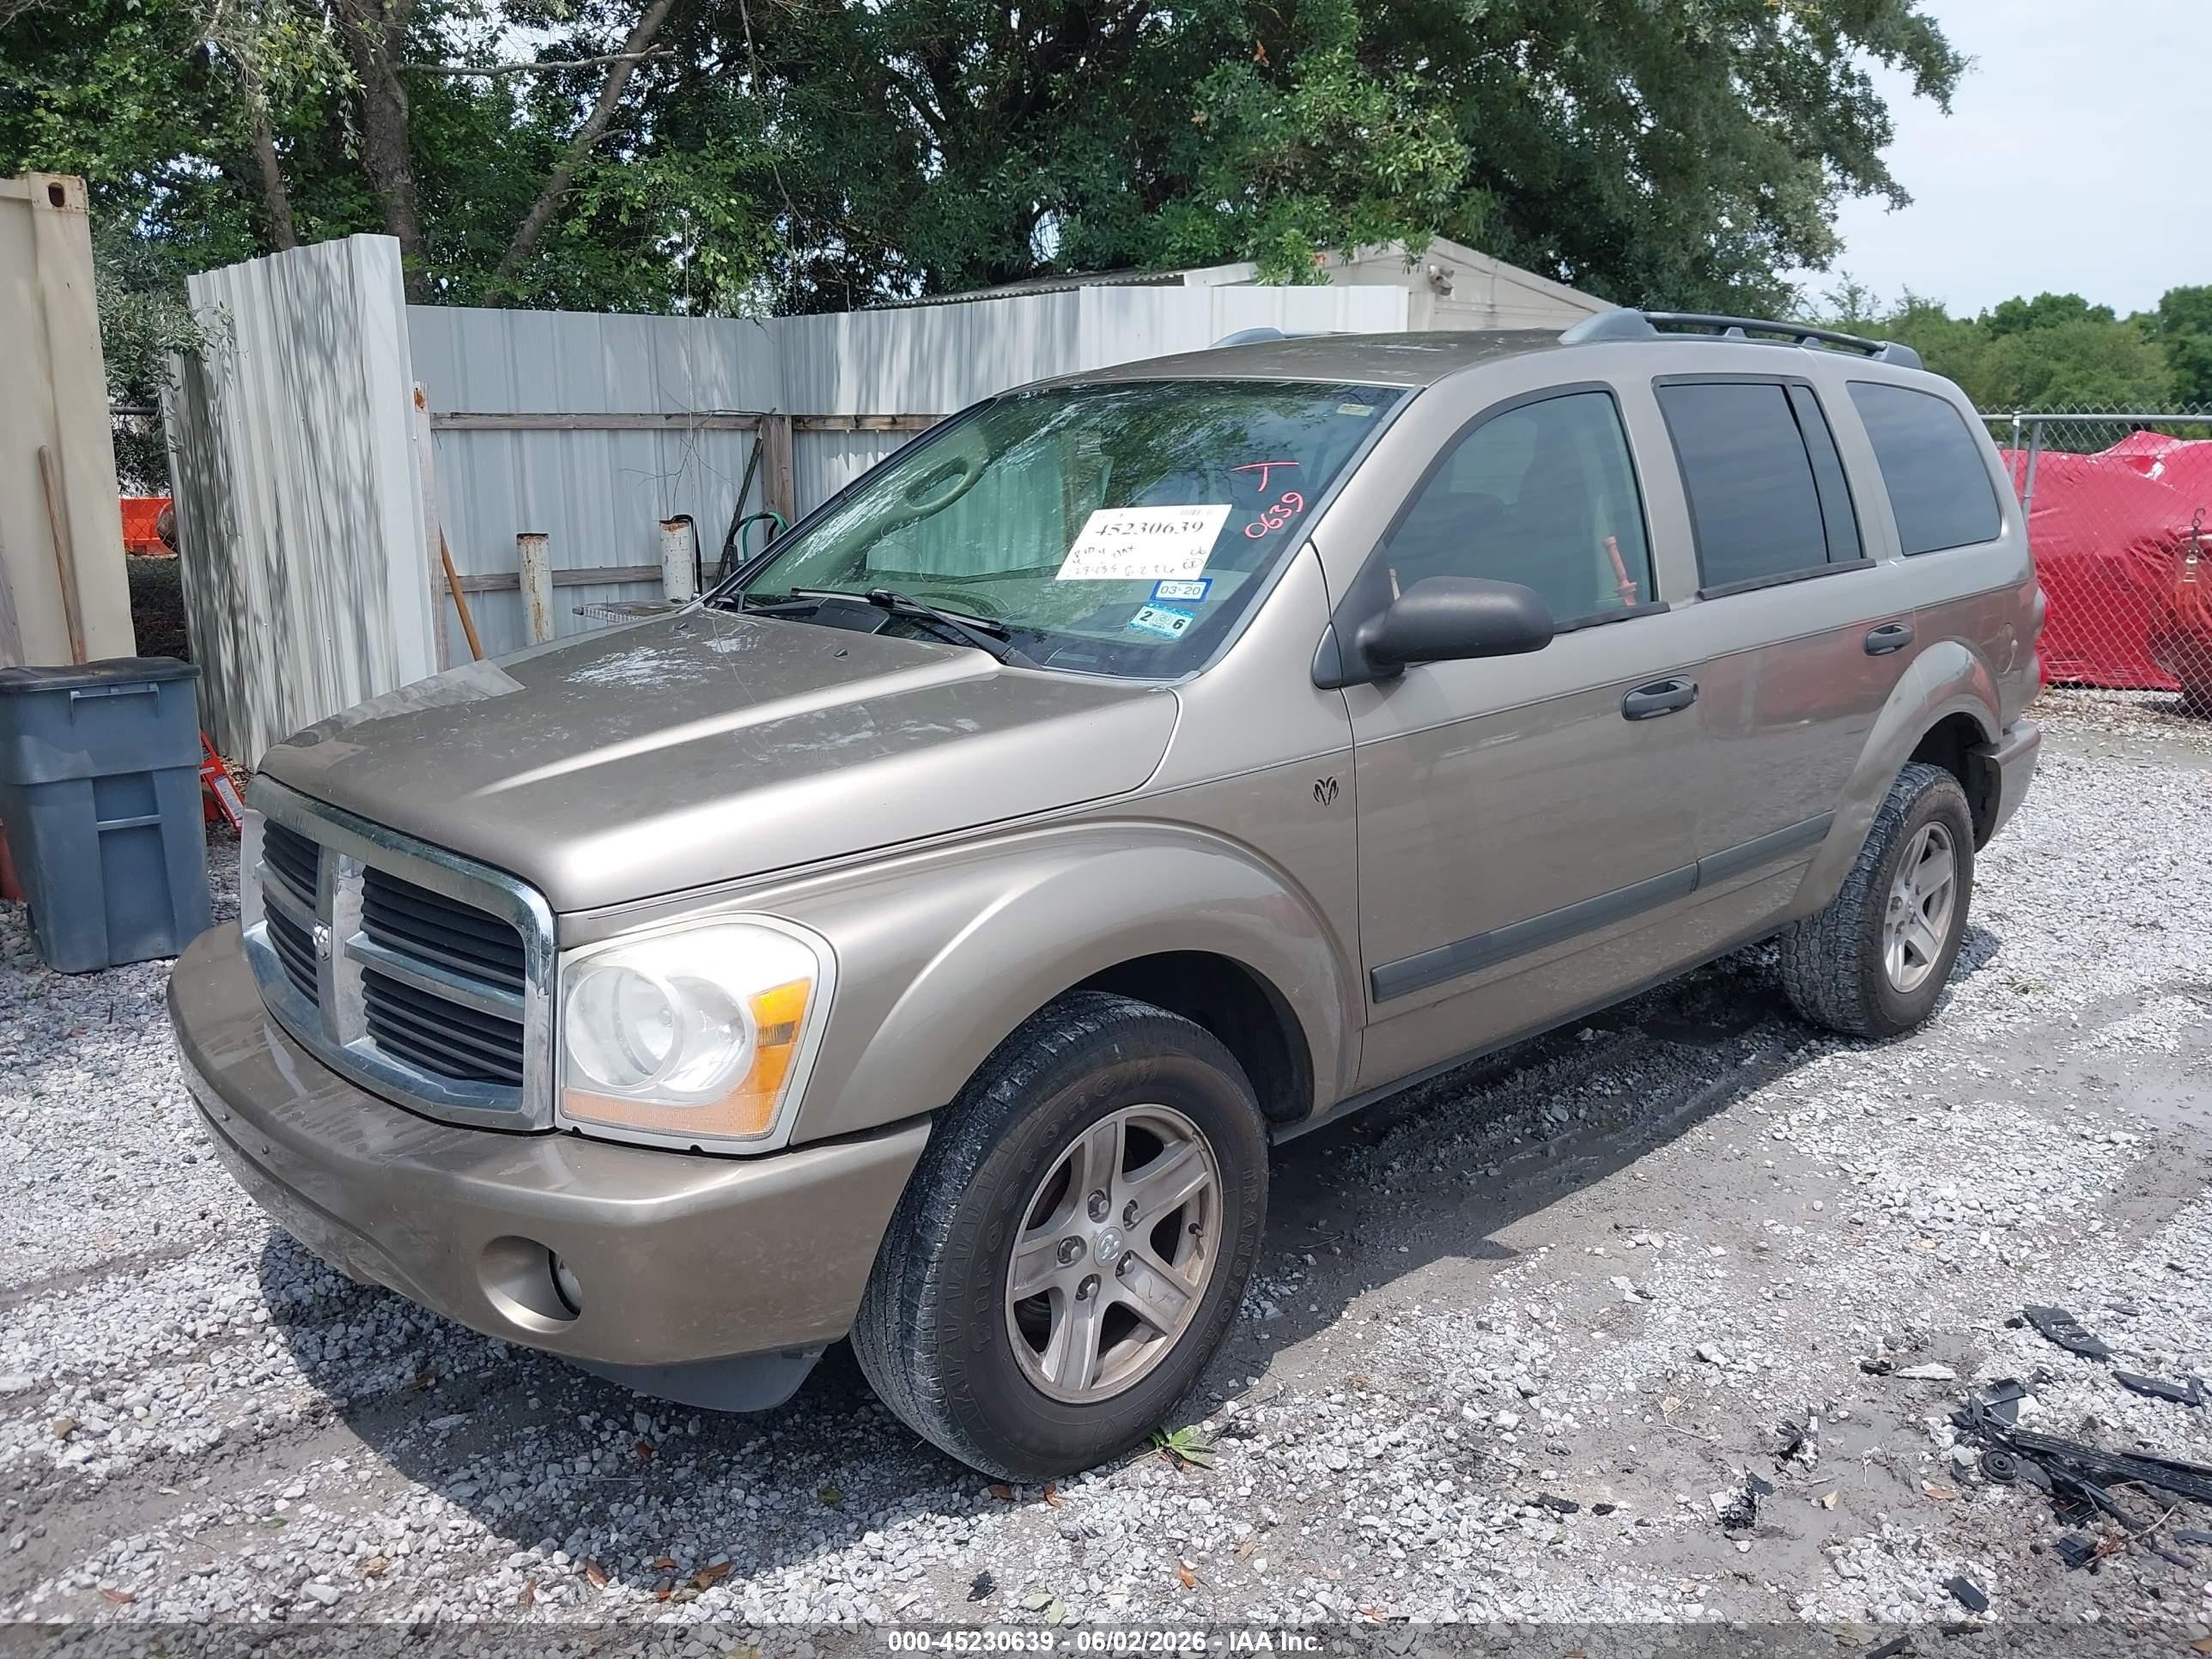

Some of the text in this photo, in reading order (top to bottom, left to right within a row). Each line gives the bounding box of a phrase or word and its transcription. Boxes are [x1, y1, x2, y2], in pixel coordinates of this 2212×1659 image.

[1244, 491, 1304, 539] 0639
[1095, 520, 1205, 537] 45230639
[1139, 611, 1154, 622] 2
[1172, 618, 1186, 629] 6
